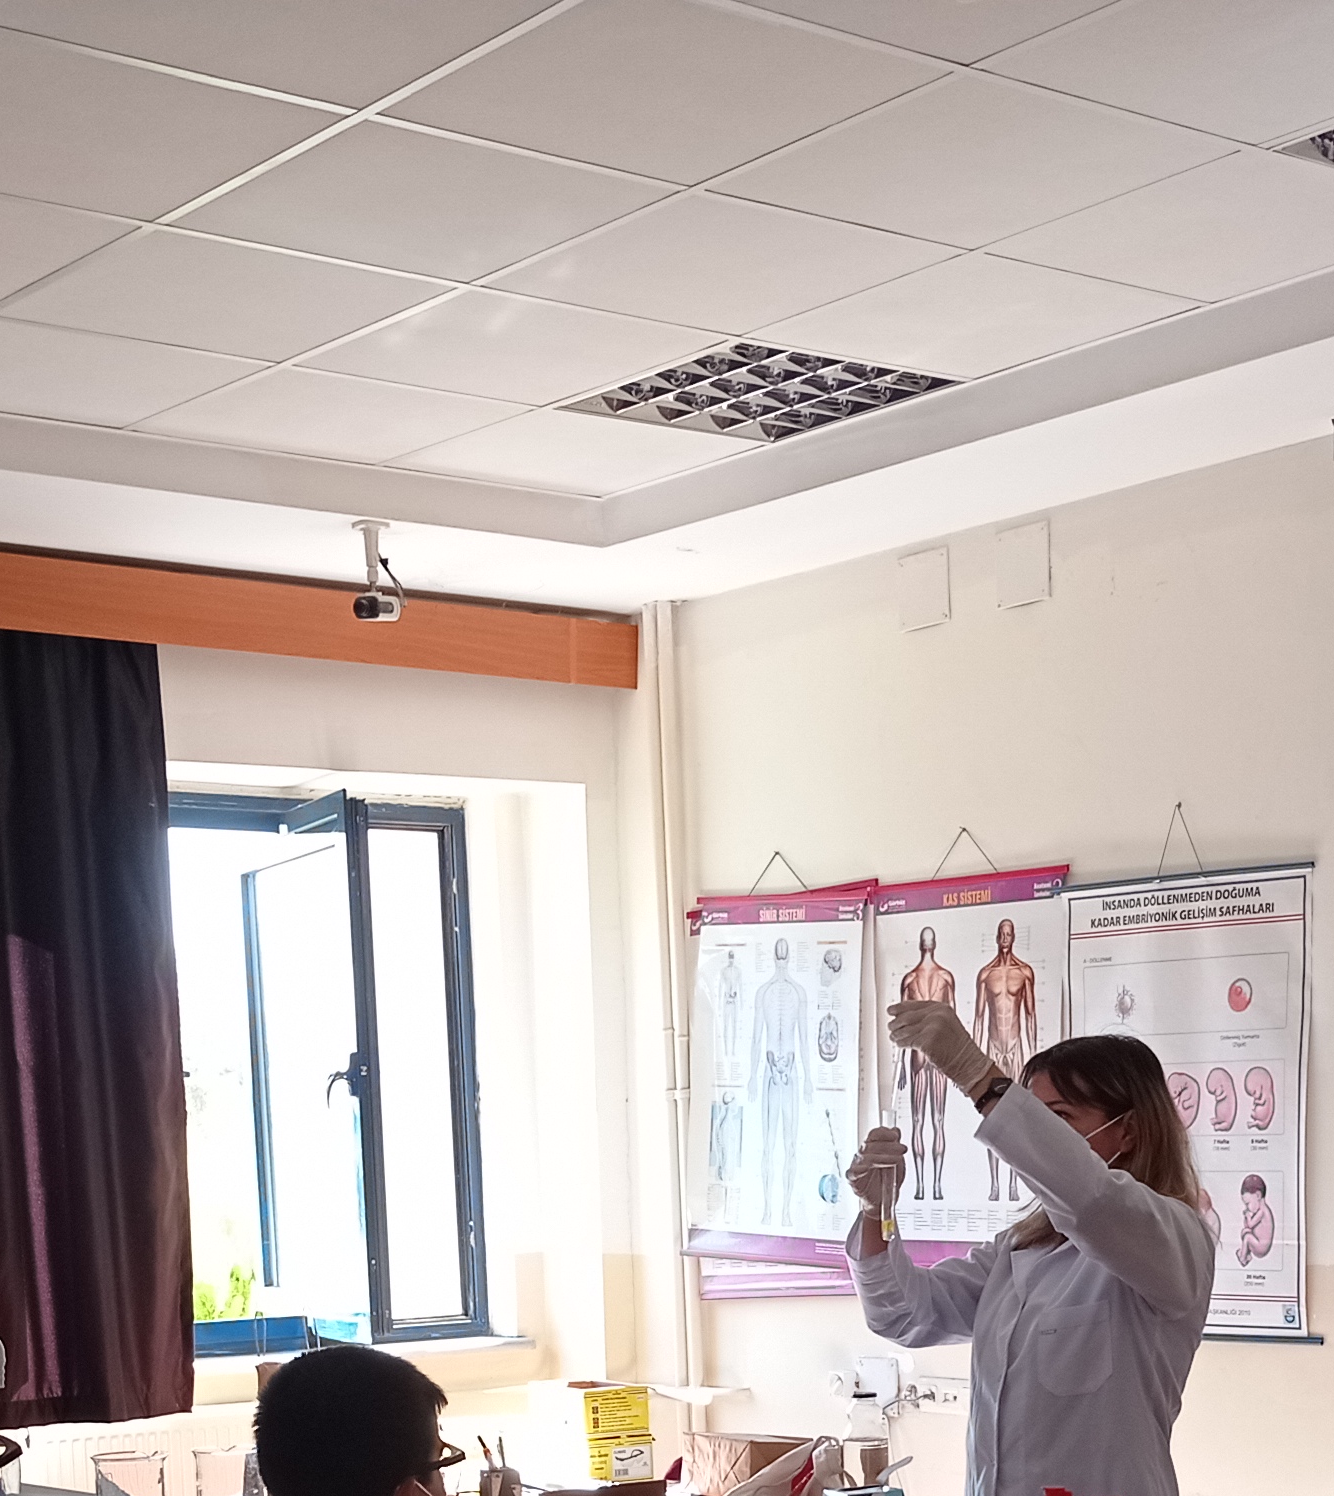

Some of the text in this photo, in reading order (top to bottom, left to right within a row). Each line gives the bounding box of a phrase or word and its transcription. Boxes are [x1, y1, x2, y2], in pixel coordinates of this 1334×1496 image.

[943, 886, 991, 906] KAS SİSTEMİ
[1102, 886, 1262, 911] İNSANDA DÖLLENMEDEN DOĞUMA
[759, 905, 806, 922] SİNİR SİSTEMİ
[853, 903, 863, 921] 3
[1091, 902, 1275, 928] KADAR EMBRİYONİK GELİŞİM SAFHALARI
[1208, 1308, 1237, 1316] AŞKANLIĞI
